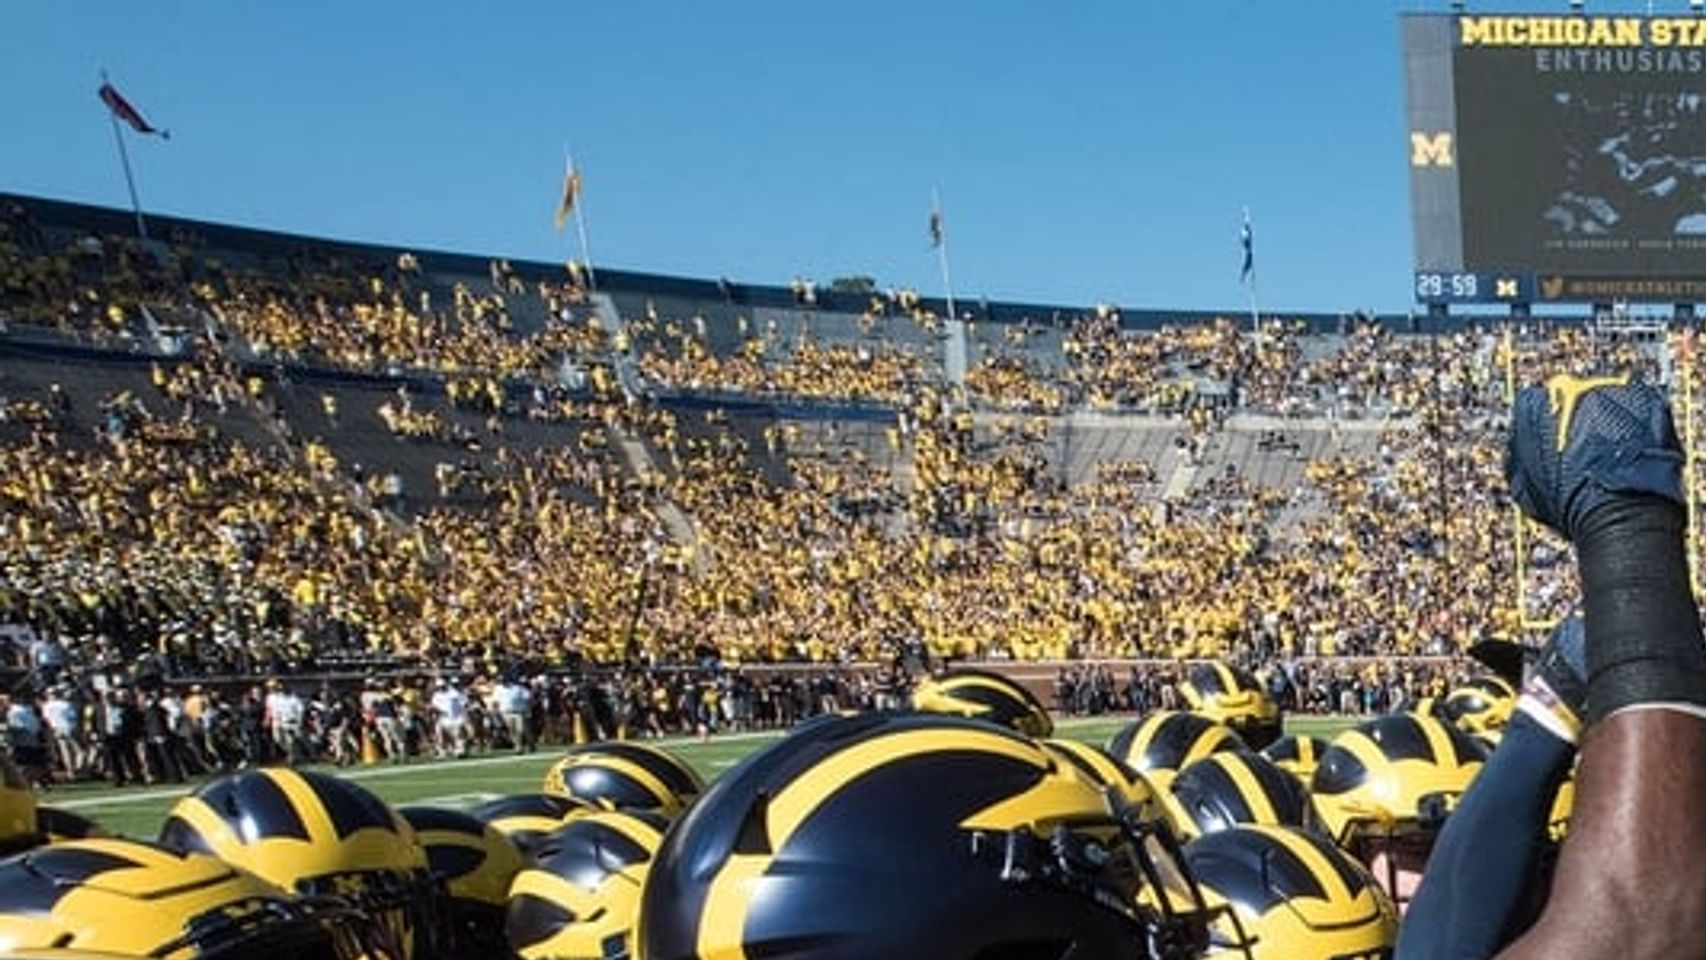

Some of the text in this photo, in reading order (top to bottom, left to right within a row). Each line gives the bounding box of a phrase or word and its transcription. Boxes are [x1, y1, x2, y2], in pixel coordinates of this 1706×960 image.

[1461, 17, 1642, 46] MICHIGAN
[1410, 132, 1453, 167] M
[1417, 274, 1477, 297] 29:59
